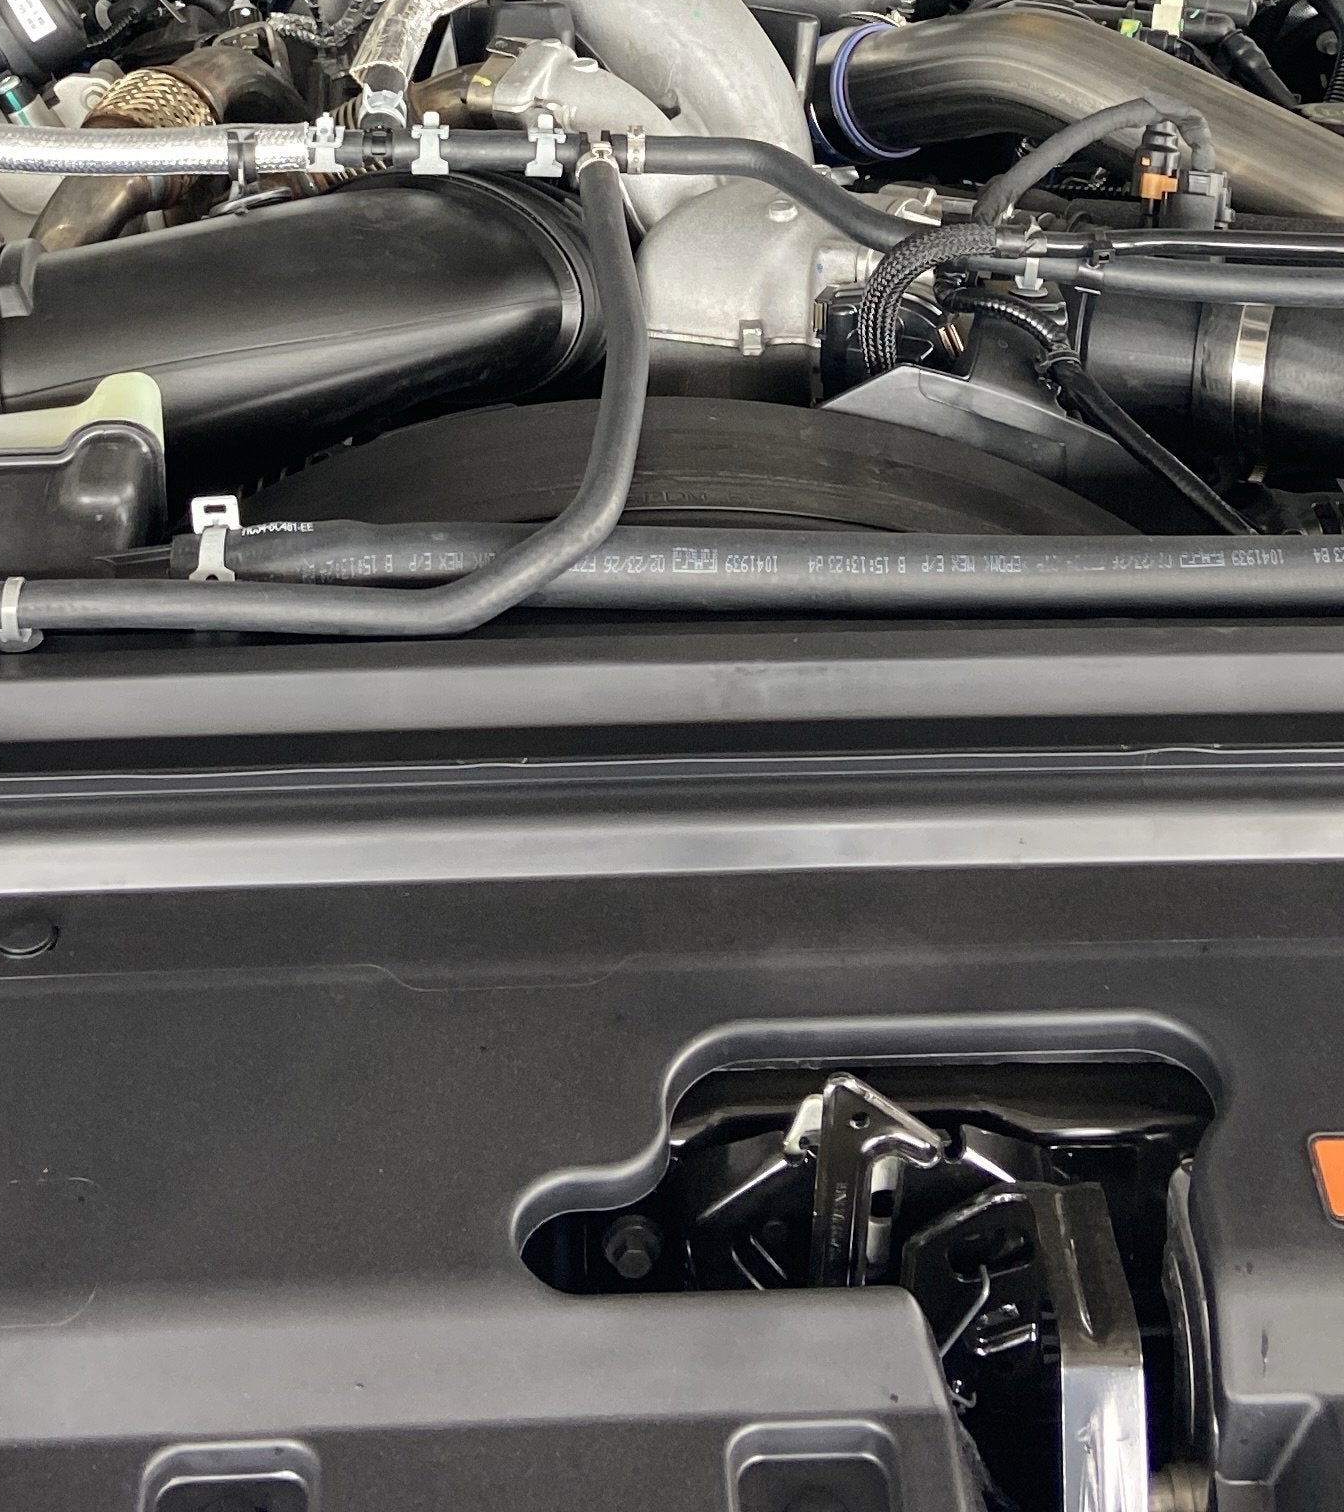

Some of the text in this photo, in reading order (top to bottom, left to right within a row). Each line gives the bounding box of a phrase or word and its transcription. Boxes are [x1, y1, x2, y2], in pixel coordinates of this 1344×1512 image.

[384, 554, 393, 573] B
[409, 552, 432, 571] E/P
[603, 554, 666, 573] 02/23/26
[724, 554, 779, 573] 1041939
[827, 555, 890, 573] 15:13:23
[896, 555, 907, 573] B
[921, 555, 946, 572] E/P
[1230, 549, 1285, 567] 1041939
